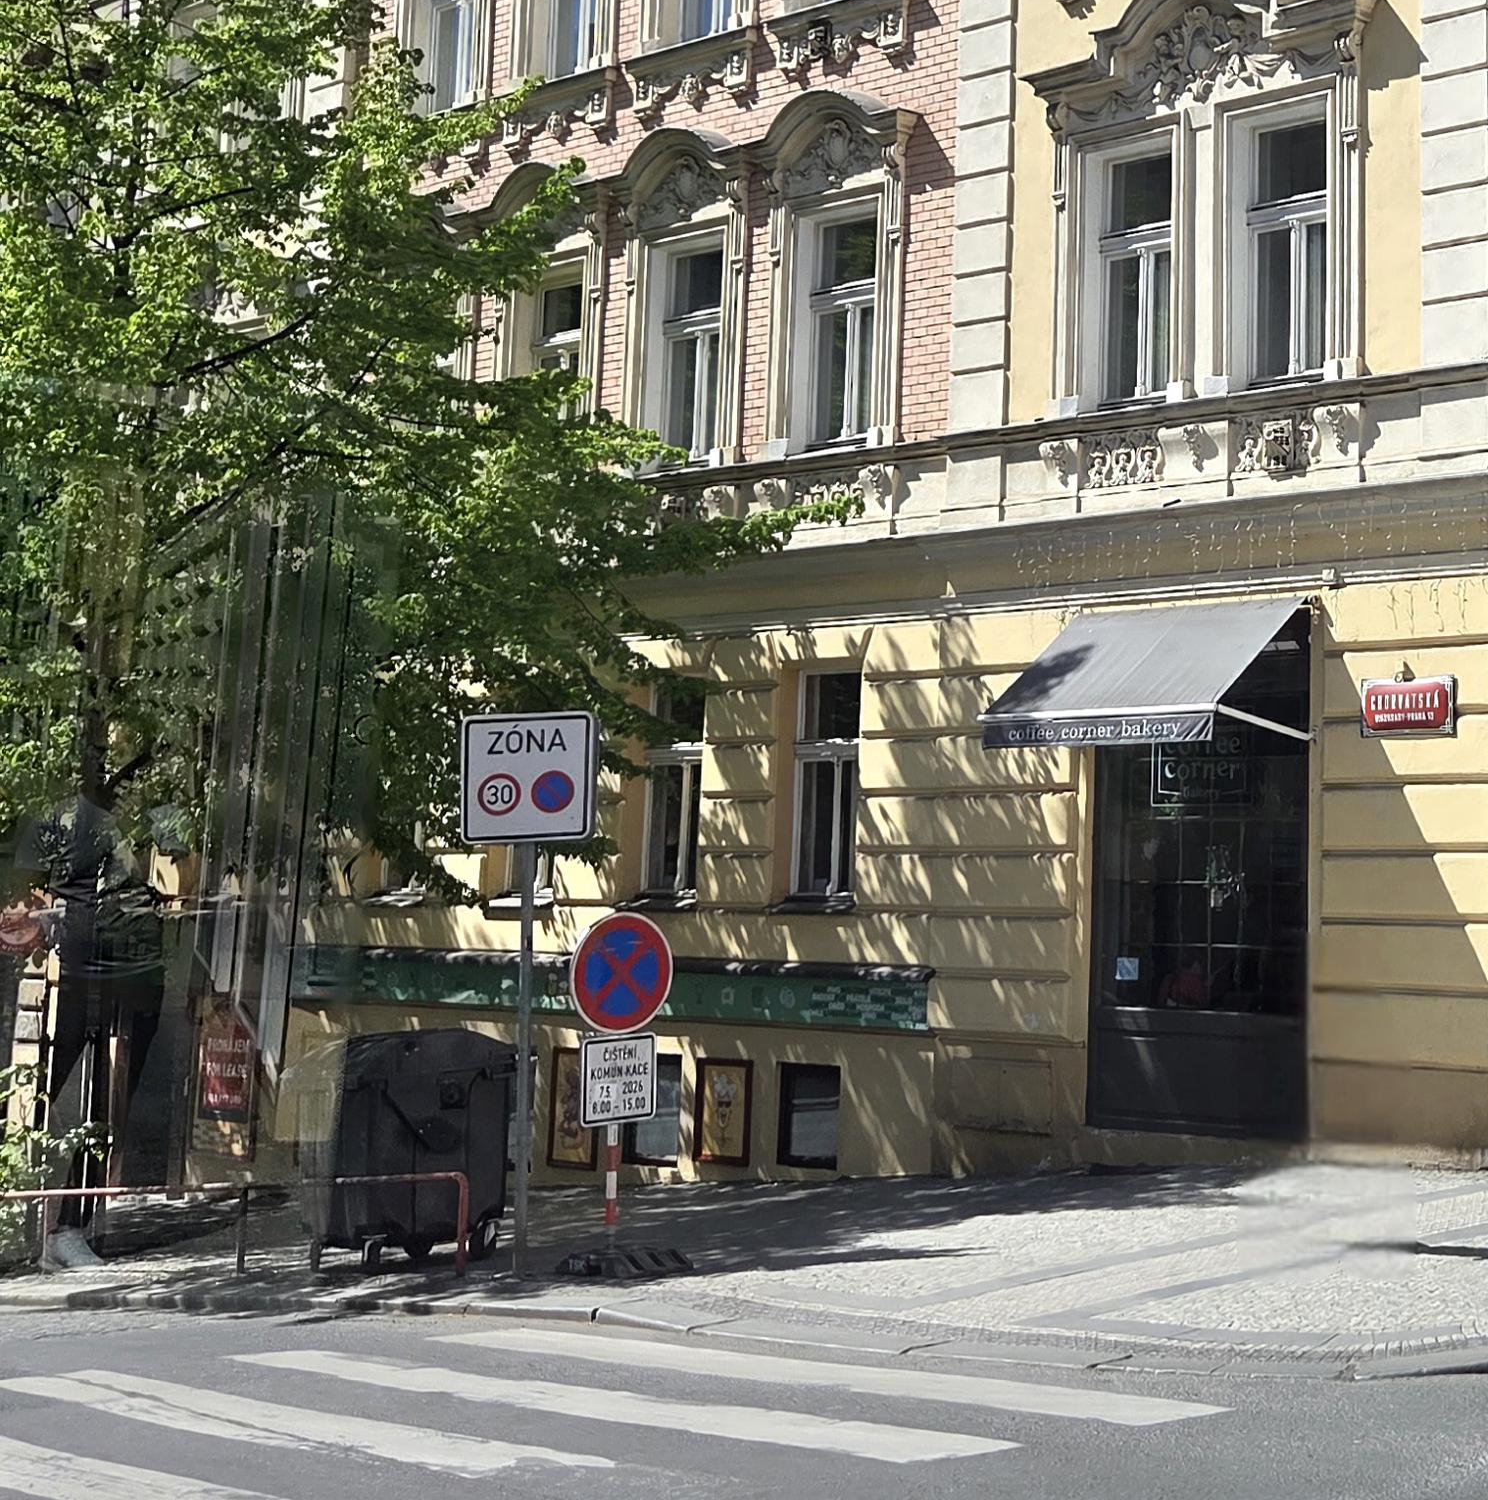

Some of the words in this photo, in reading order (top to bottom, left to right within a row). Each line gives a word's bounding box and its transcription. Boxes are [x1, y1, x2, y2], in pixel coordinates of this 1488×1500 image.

[1370, 689, 1440, 711] CHORVATSKÁ
[487, 724, 567, 755] ZÓNA
[1008, 724, 1054, 741] coffee
[1061, 722, 1115, 740] corner
[1121, 719, 1181, 739] bakery
[1164, 760, 1240, 780] corner
[486, 784, 513, 806] 30
[603, 1044, 638, 1062] ČIŠTĚNÍ
[590, 1062, 649, 1080] KOMUNKACE
[622, 1080, 644, 1095] 2026
[592, 1100, 611, 1115] 8.00
[622, 1096, 646, 1111] 15.00
